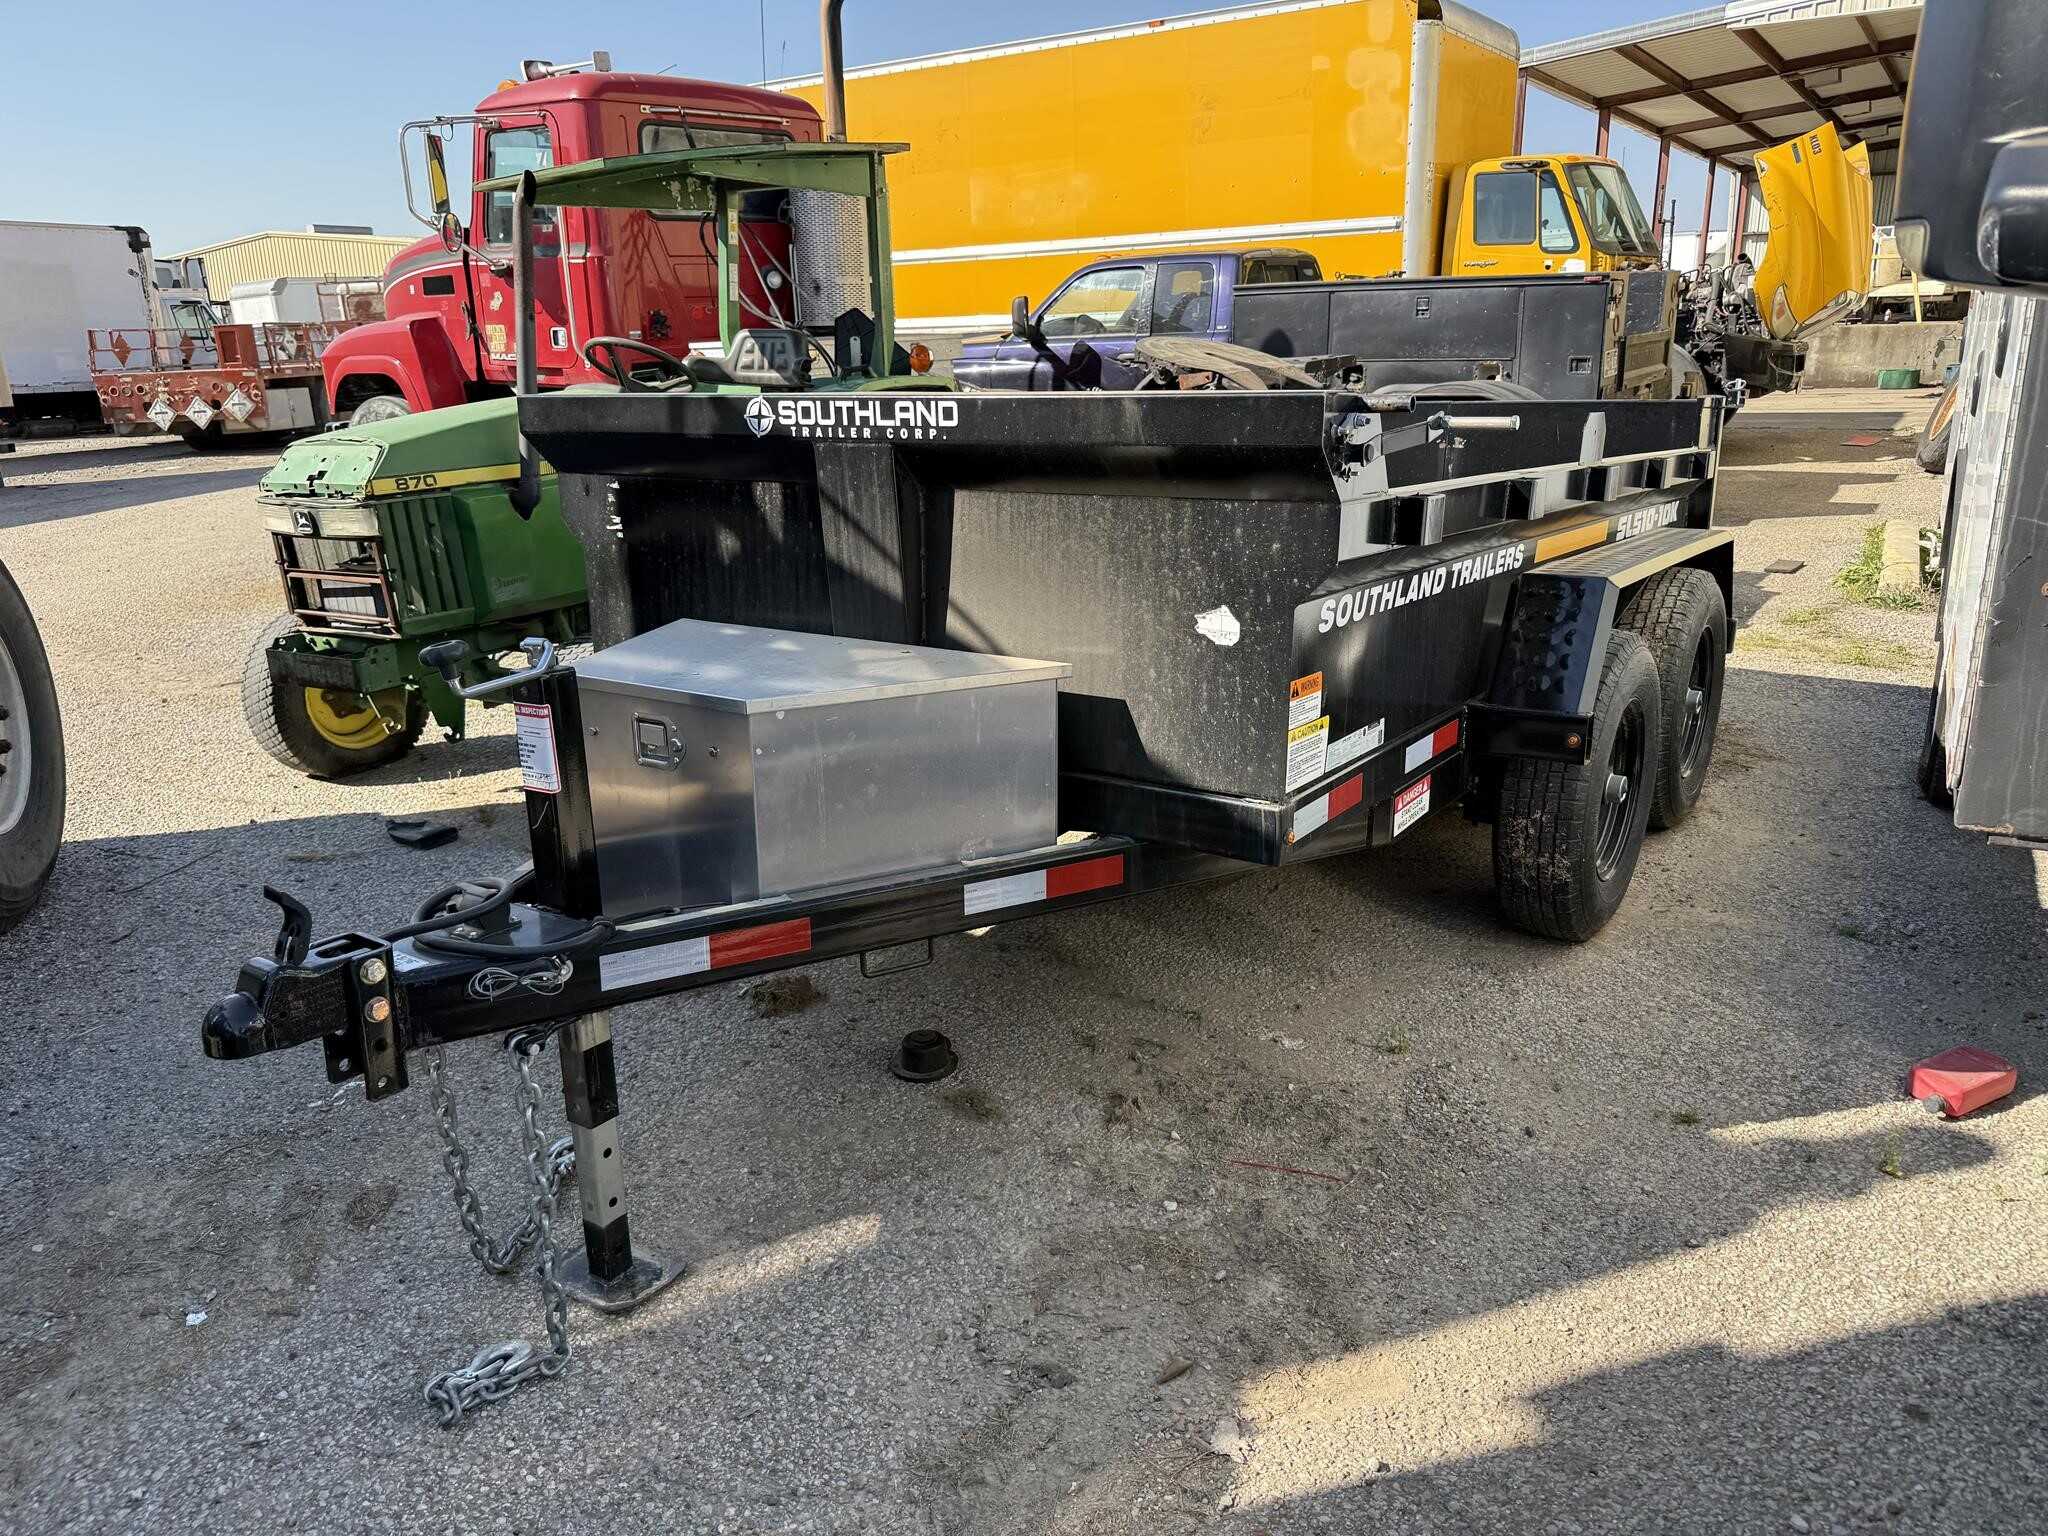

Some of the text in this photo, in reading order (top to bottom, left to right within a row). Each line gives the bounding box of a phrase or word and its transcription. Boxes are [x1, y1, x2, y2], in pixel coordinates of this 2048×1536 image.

[777, 400, 959, 427] SOUTHLAND
[790, 426, 947, 440] TRAILER CORP.
[394, 474, 438, 491] 870
[1318, 544, 1526, 634] SOUTHLAND TRAILERS
[1297, 724, 1319, 740] CAUTION
[1402, 783, 1424, 806] DANGER
